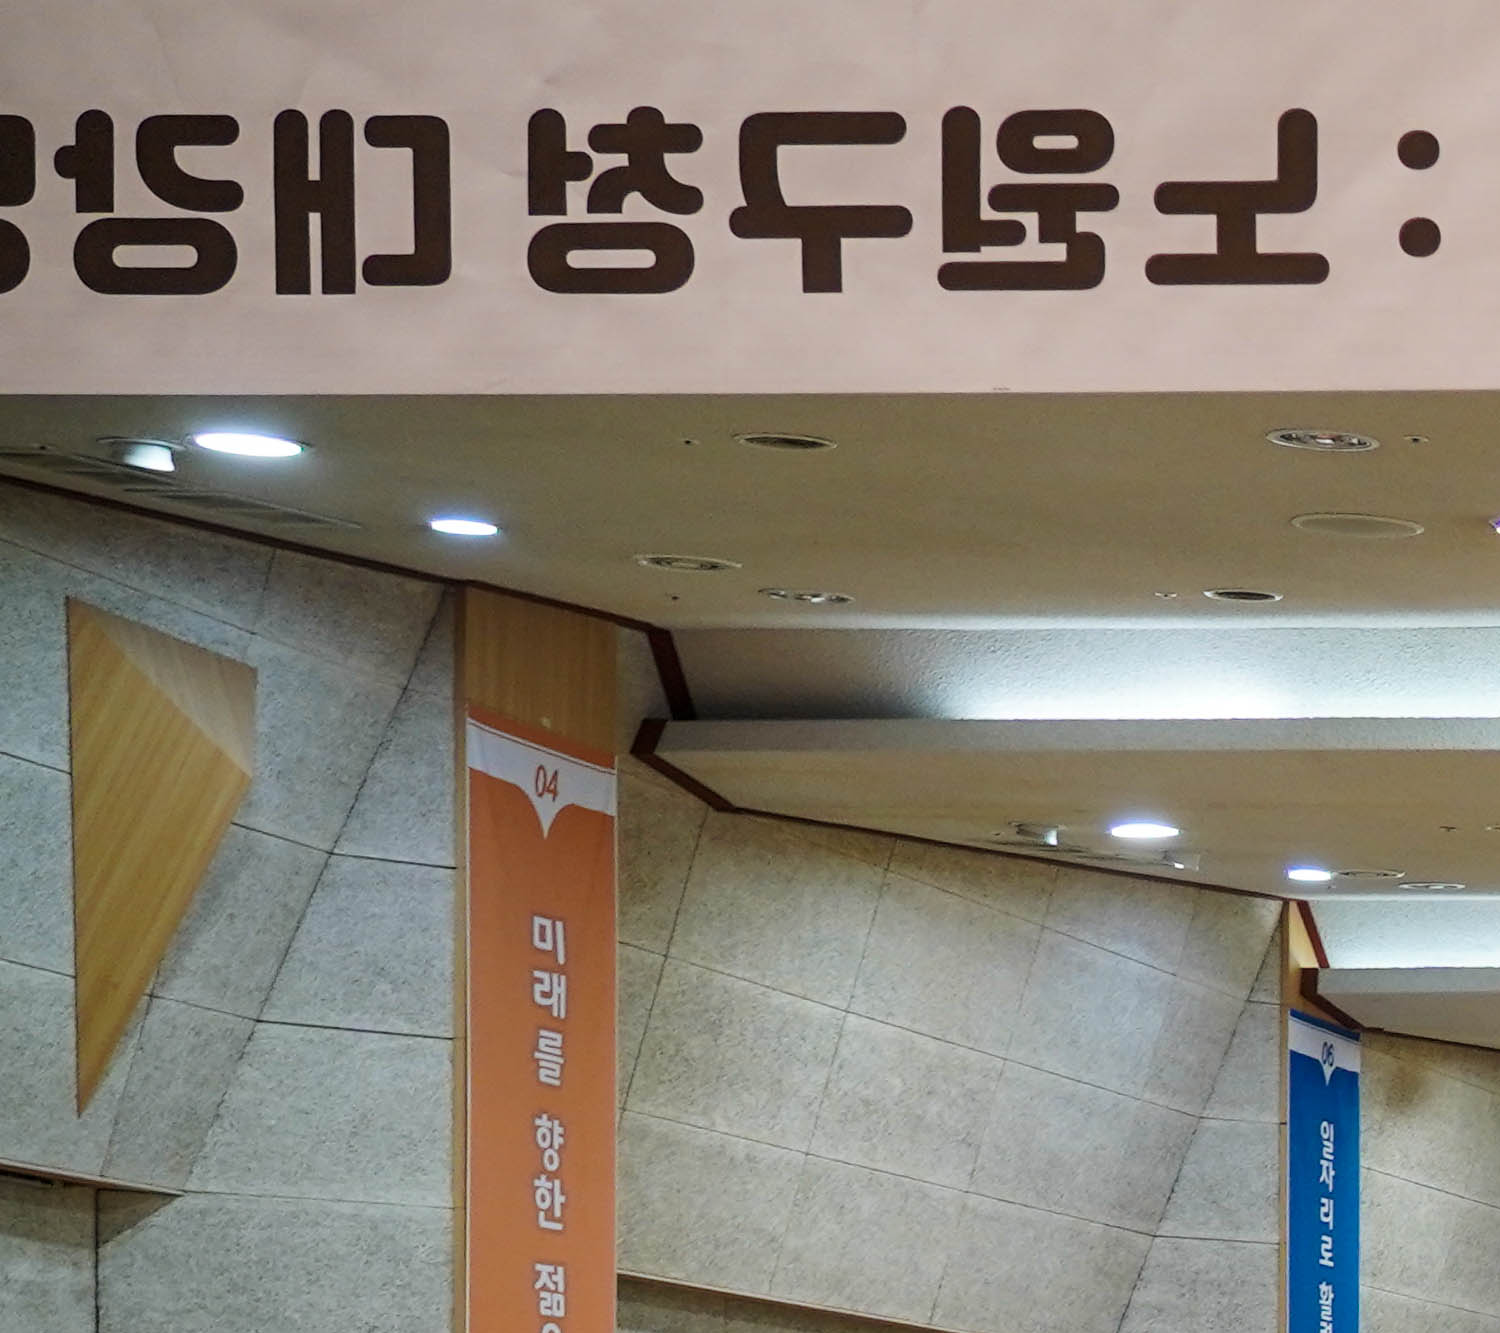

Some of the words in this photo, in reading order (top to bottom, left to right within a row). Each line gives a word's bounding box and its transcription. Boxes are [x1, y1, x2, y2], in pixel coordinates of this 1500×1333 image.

[534, 763, 560, 802] 04
[533, 916, 565, 1085] 미래를
[1321, 1040, 1336, 1069] 06
[533, 1114, 565, 1231] 향한
[1318, 1121, 1336, 1267] 일자리로
